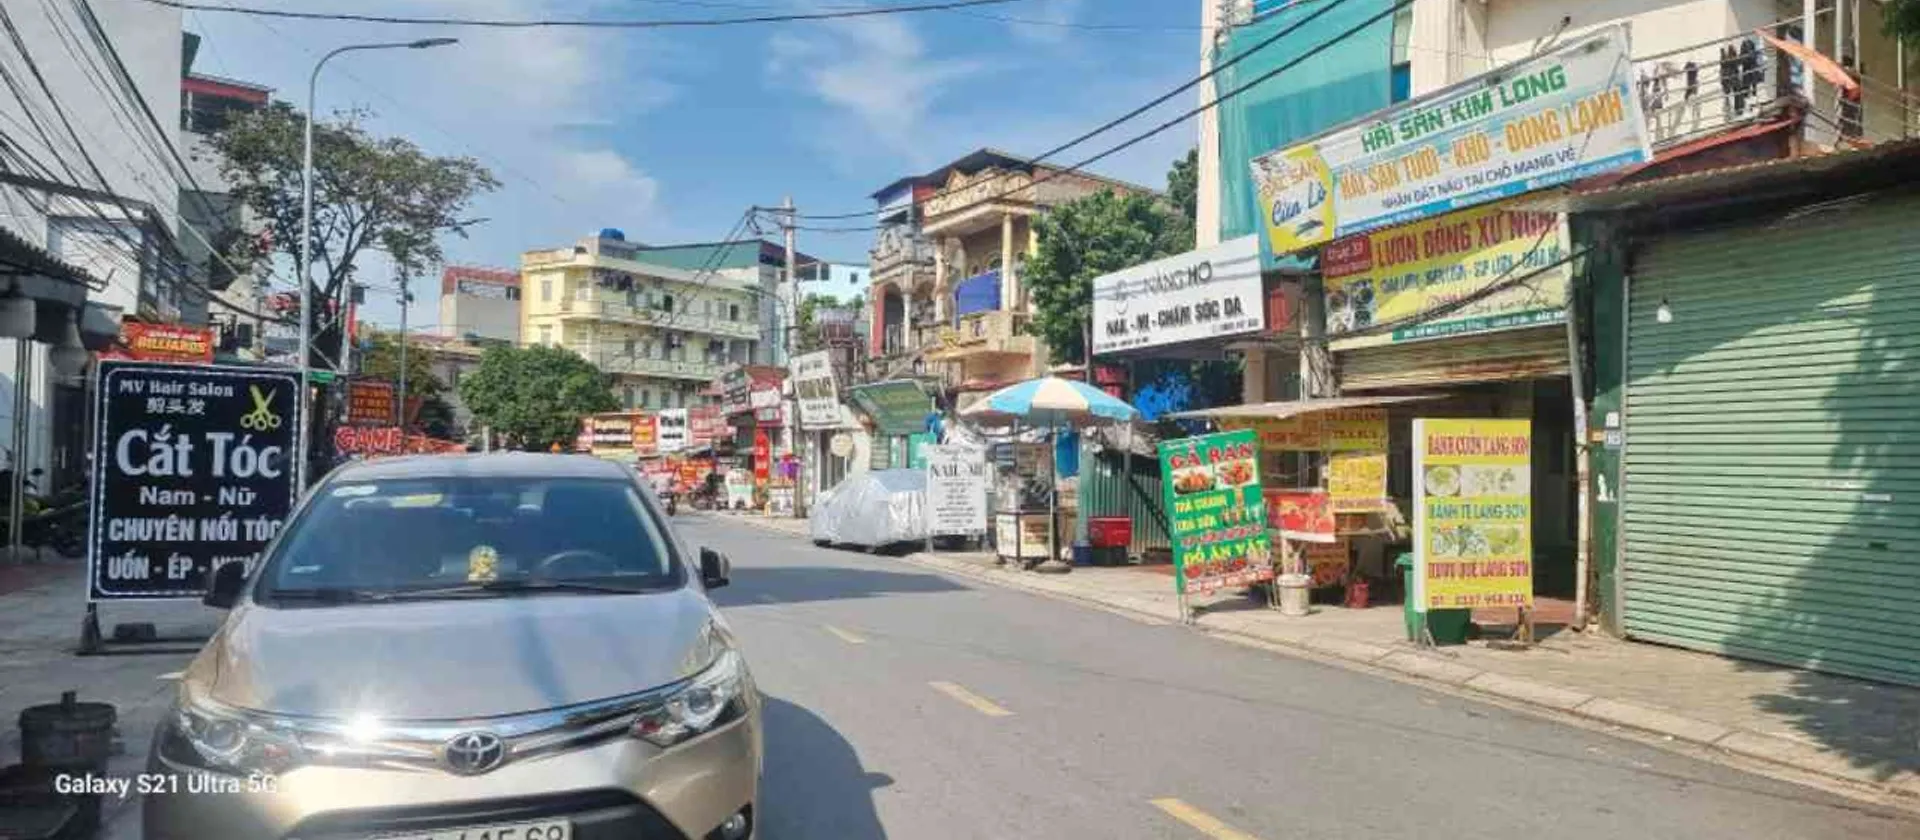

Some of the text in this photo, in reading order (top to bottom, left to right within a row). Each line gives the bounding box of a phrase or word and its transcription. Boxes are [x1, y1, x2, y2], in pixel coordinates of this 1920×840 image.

[1361, 121, 1395, 152] HẢI
[1400, 108, 1443, 140] SẢN
[1501, 65, 1567, 108] LONG
[1514, 155, 1554, 176] MANG
[120, 380, 233, 397] MV Hair Salon
[116, 423, 282, 478] Cắt Tóc
[1171, 443, 1200, 469] GÀ
[139, 486, 196, 505] Nam
[218, 486, 257, 506] Nữ
[109, 514, 196, 542] CHUYÊN
[201, 510, 238, 542] NỐI
[108, 548, 149, 580] UỐN
[168, 552, 194, 580] ÉP
